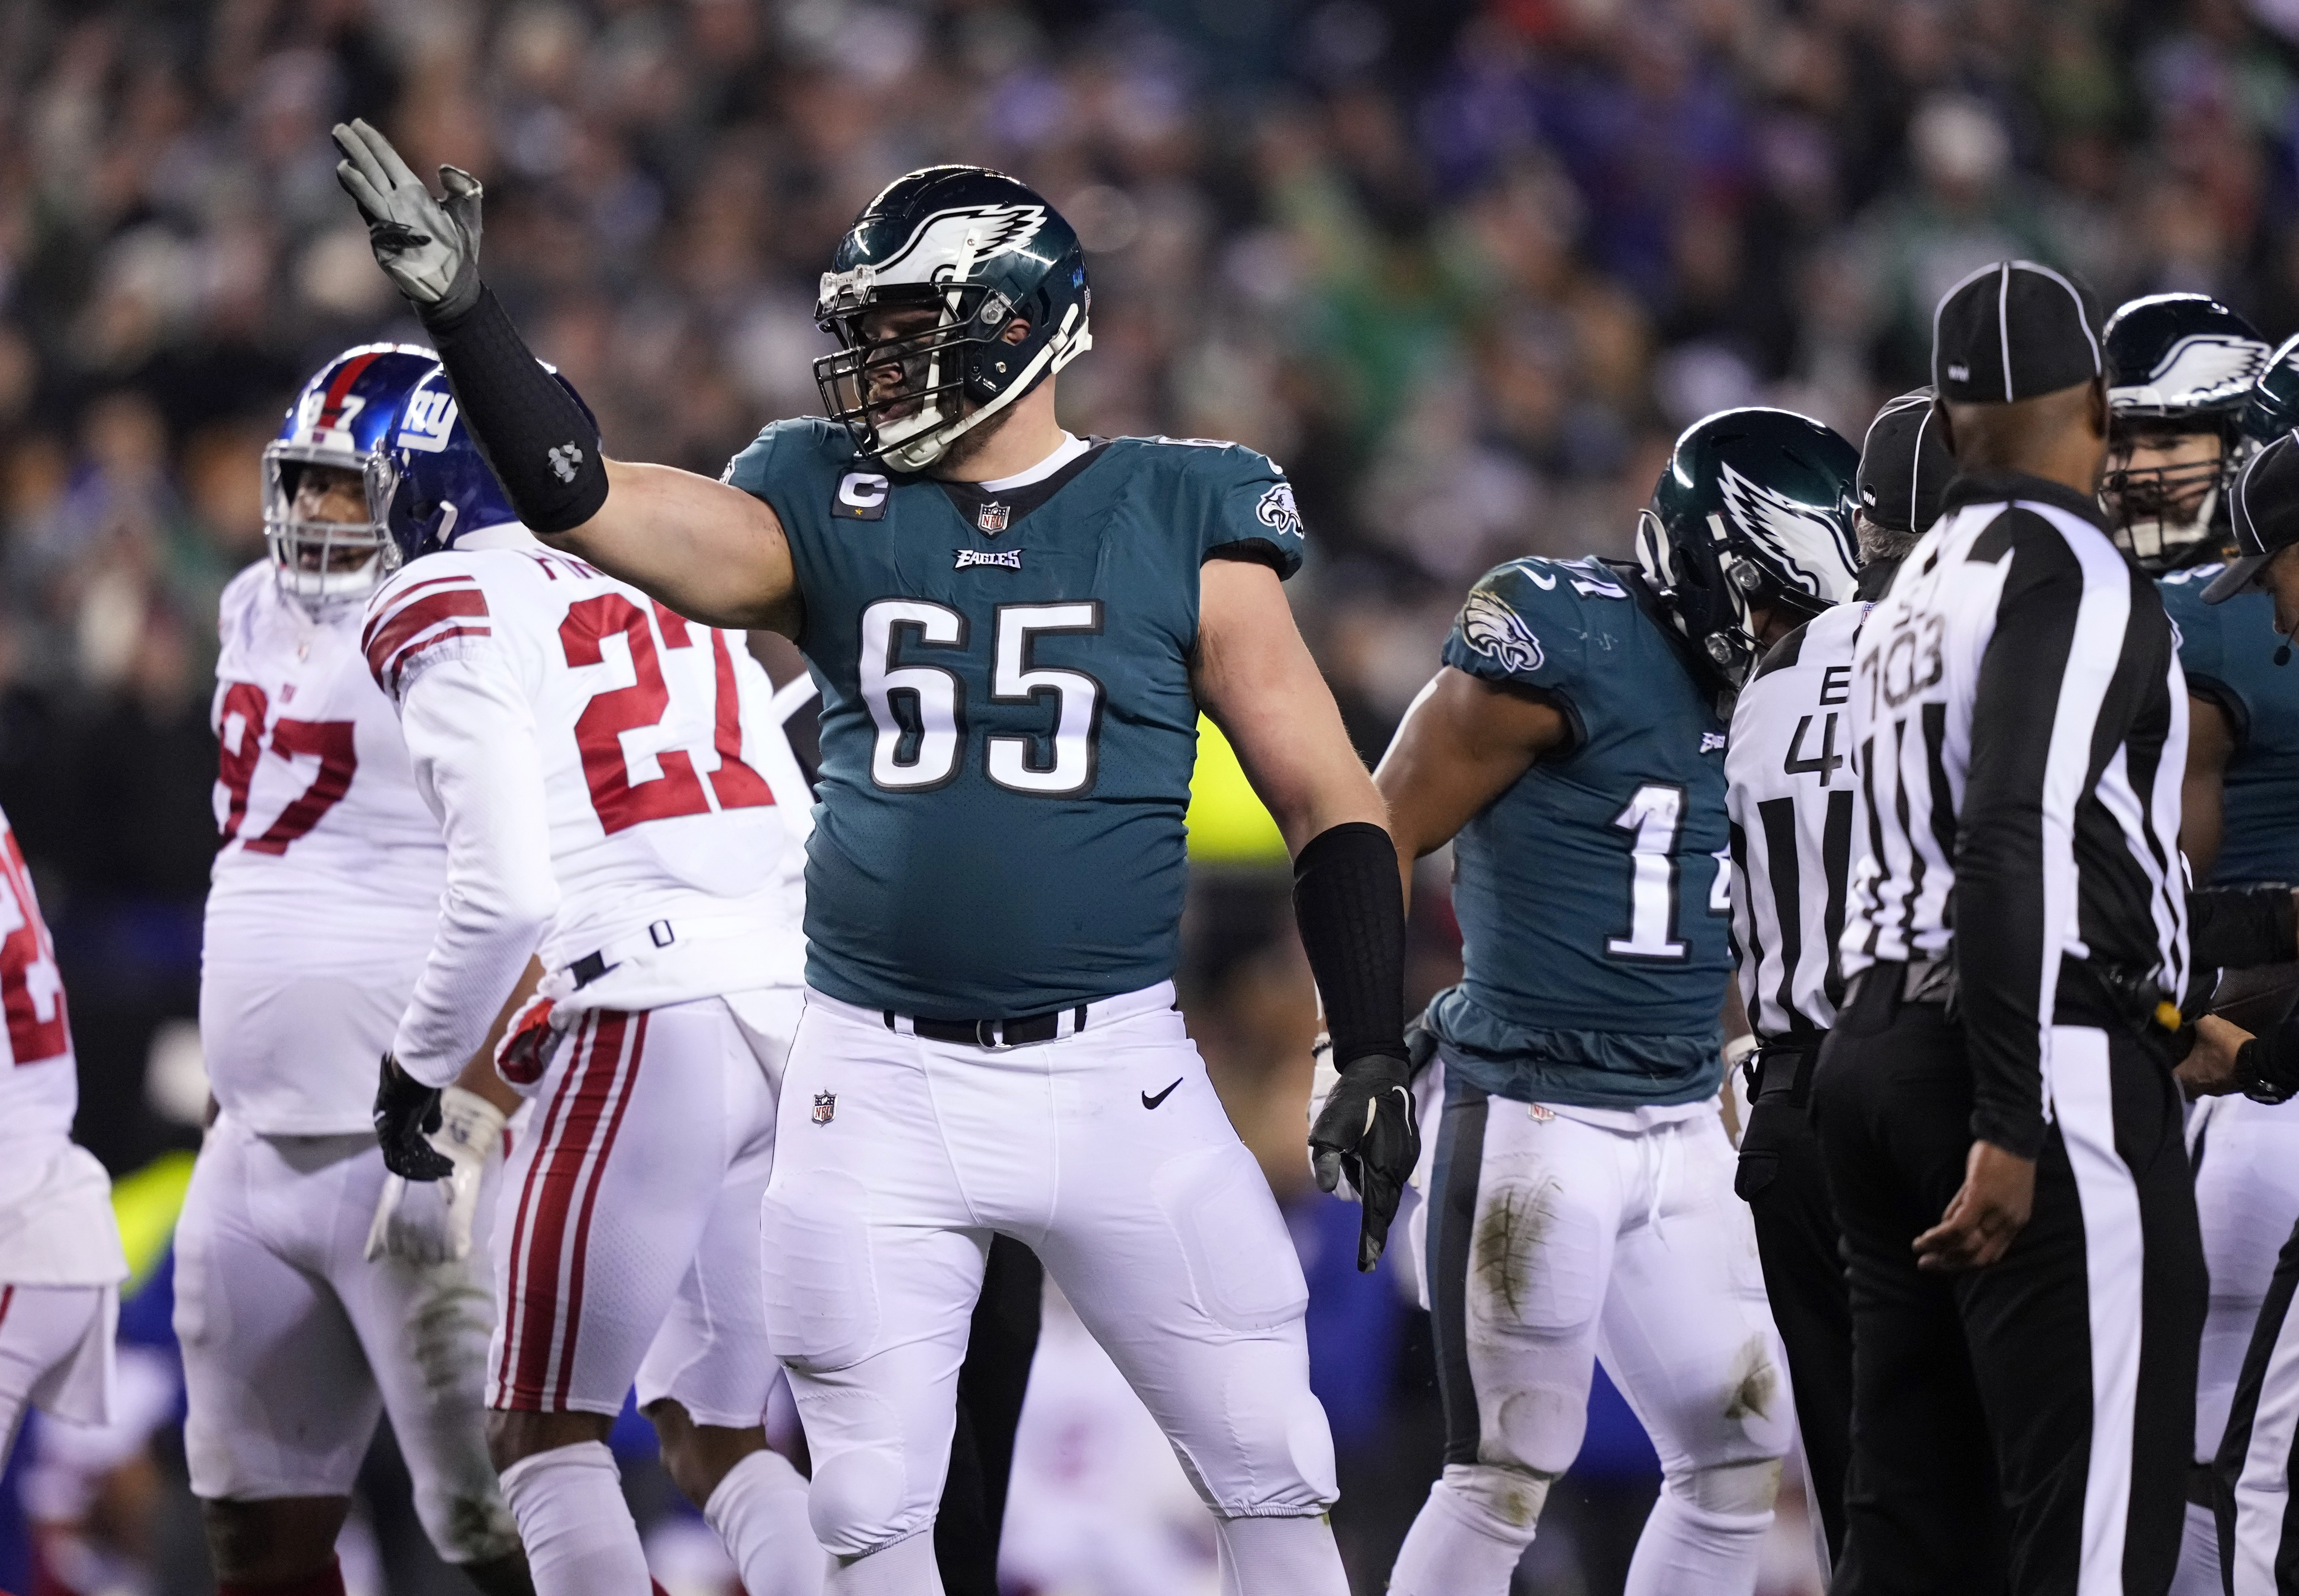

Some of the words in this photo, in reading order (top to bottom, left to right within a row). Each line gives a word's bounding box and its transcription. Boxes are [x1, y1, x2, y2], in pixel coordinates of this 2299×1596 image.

[839, 472, 889, 508] C
[1863, 490, 1876, 507] WM
[982, 515, 1003, 528] NFL
[955, 549, 1022, 569] EAGLES
[1861, 612, 1944, 722] 103
[558, 592, 777, 836] 27
[858, 598, 1105, 796] 65
[1604, 782, 1730, 963] 1
[815, 1106, 832, 1120] NFL
